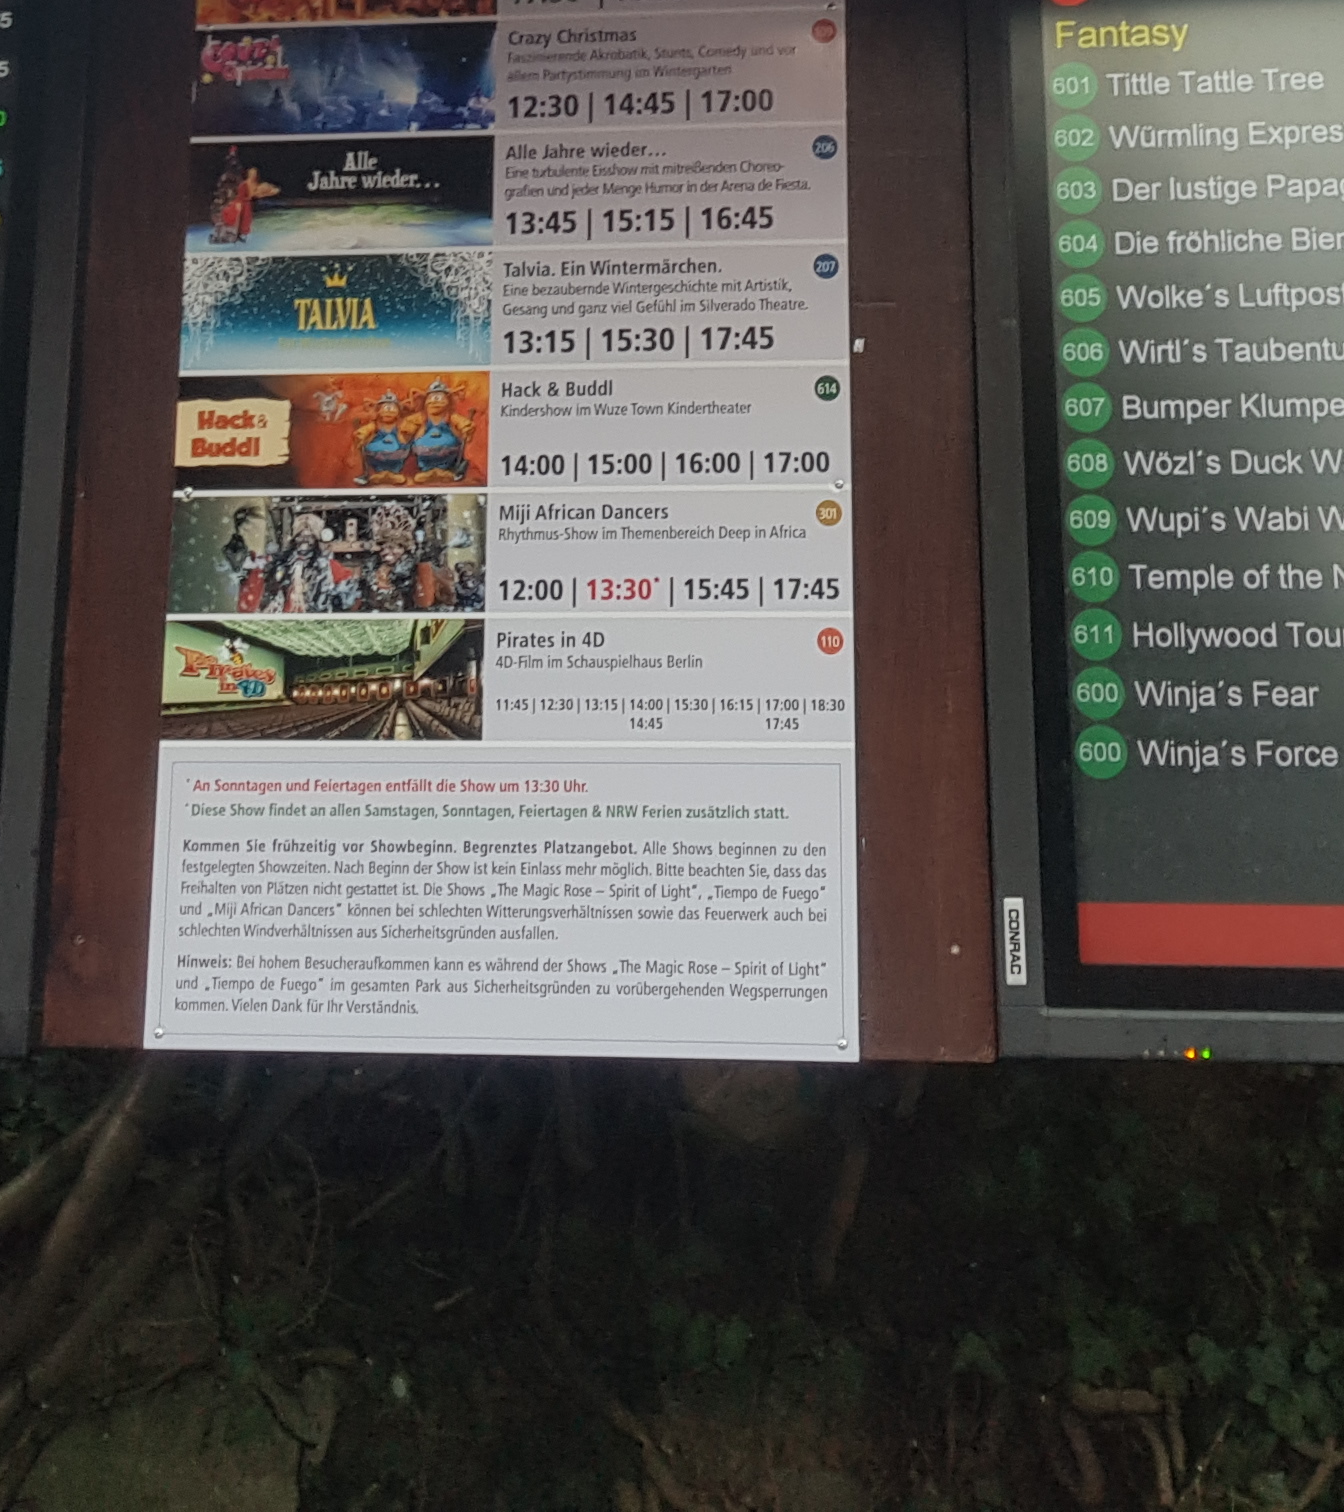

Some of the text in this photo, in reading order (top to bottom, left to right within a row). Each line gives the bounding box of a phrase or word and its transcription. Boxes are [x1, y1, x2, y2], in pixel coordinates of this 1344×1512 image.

[508, 28, 636, 49] Crazy Christmas
[1055, 19, 1189, 52] Fantasy
[1106, 68, 1324, 96] Tittle Tattle Tree
[509, 89, 773, 118] 12:30 14:45 17:00
[1109, 122, 1238, 154] Würmling
[1113, 178, 1161, 201] Der
[1170, 176, 1257, 204] lustige
[507, 206, 773, 234] 13:45 15:15 16:45
[1115, 231, 1159, 254] Die
[1167, 228, 1282, 257] fröhliche
[504, 258, 721, 277] Talvia. Ein Wintermärchen.
[294, 298, 375, 333] TALVIA
[504, 326, 774, 353] 13:15 15:30 17:45
[502, 380, 612, 397] Hack & Buddl
[1123, 395, 1231, 424] Bumper
[502, 452, 829, 475] 14:00 15:00 16:00 17:00
[1231, 449, 1303, 474] Duck
[500, 504, 668, 525] Miji African Dancers
[1235, 506, 1309, 531] Wabi
[500, 578, 839, 600] 12:00 15:45 17:45
[1129, 564, 1234, 595] Temple
[1243, 564, 1270, 589] of
[1278, 564, 1322, 589] the
[497, 631, 604, 649] Pirates in 4D
[822, 636, 839, 647] 110
[1134, 622, 1277, 654] Hollywood
[1253, 681, 1319, 706] Fear
[1257, 741, 1338, 767] Force
[193, 779, 588, 795] An Sonntagen und Feiertagen entfällt die Show um 13:30 Uhr.
[1009, 909, 1021, 974] CONRAC
